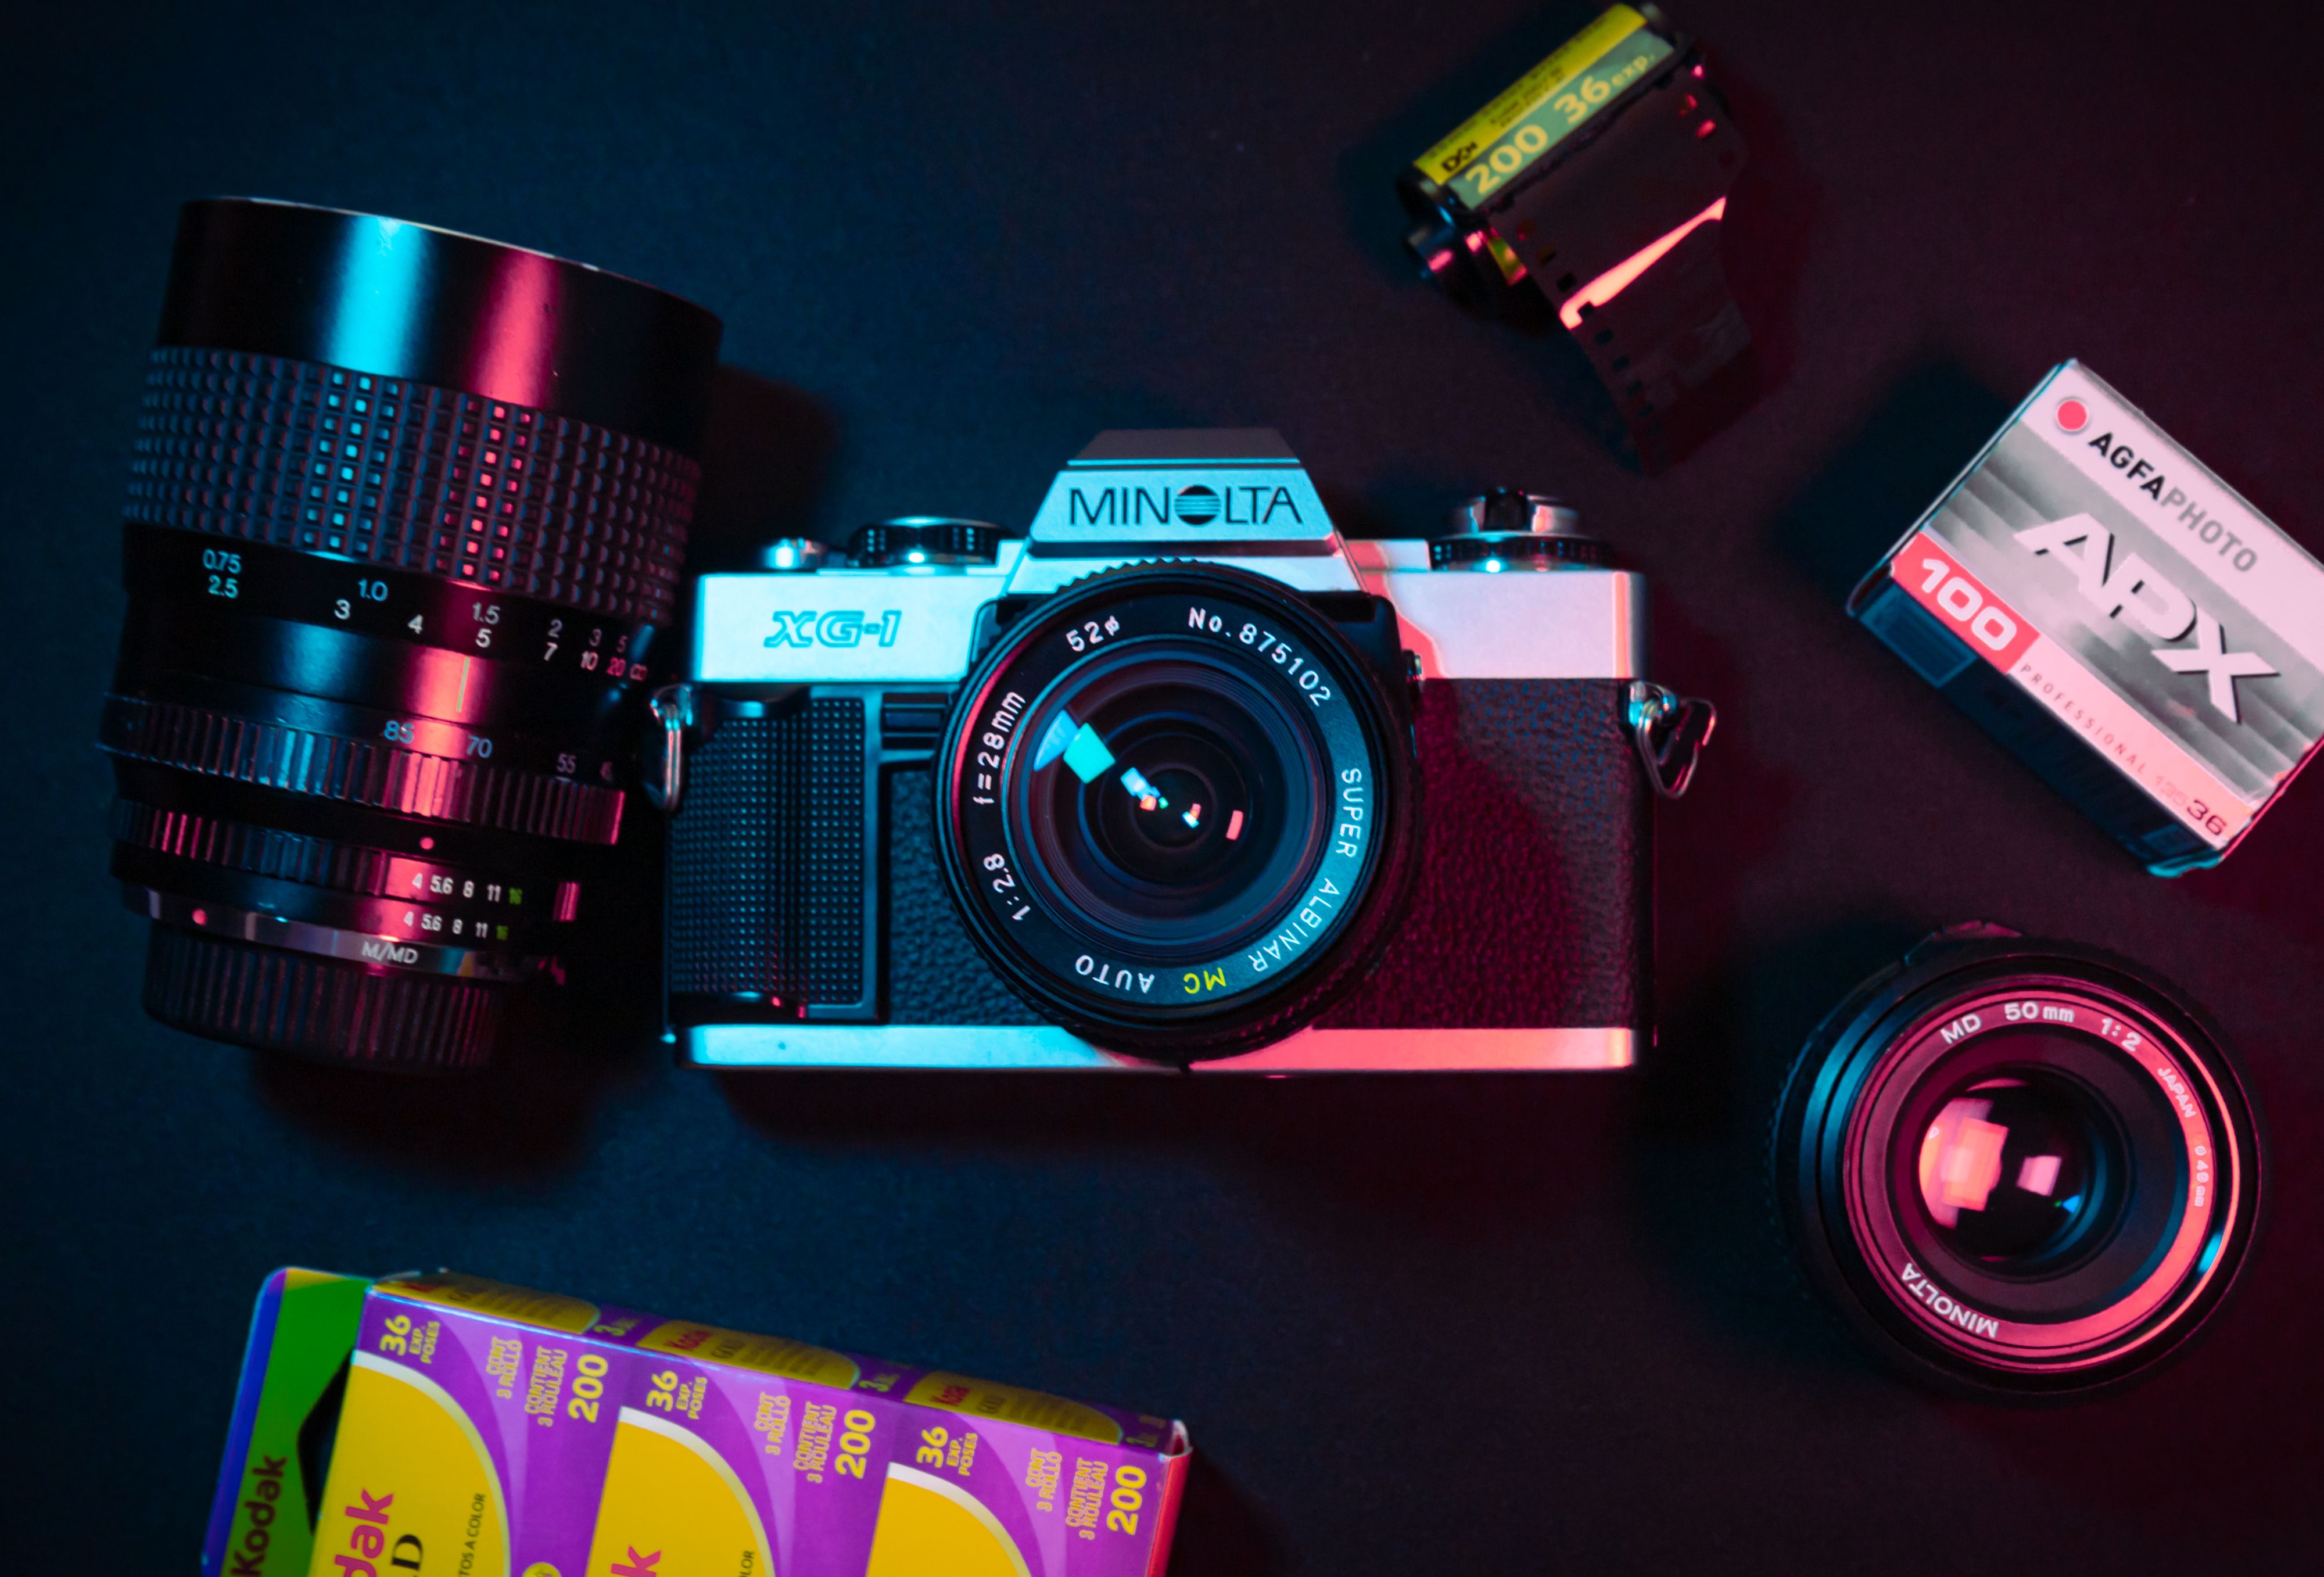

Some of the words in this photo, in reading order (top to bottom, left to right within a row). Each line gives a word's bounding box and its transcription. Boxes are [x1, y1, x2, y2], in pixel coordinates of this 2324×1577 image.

[1465, 124, 1548, 193] 200
[1554, 75, 1611, 124] 36
[1068, 483, 1304, 526] MINOLTA
[2088, 432, 2258, 573] AGFAPHOTO
[203, 549, 242, 574] 0.75
[358, 578, 388, 601] 1.0
[472, 601, 501, 625] 1.5
[548, 618, 562, 638] 2
[588, 628, 602, 647] 3
[207, 574, 239, 598] 2.5
[333, 599, 351, 620] 3
[408, 614, 423, 634] 4
[475, 628, 492, 648] 5
[543, 641, 558, 661] 7
[581, 650, 598, 671] 10
[606, 656, 626, 677] 20
[1921, 558, 2017, 651] 100
[2013, 512, 2281, 724] APX
[763, 610, 902, 647] XG-1
[383, 720, 414, 744] 85
[467, 736, 493, 758] 70
[557, 752, 576, 774] 55
[2021, 664, 2147, 775] PROFESSIONAL
[1335, 768, 1362, 859] SUPER
[2188, 798, 2228, 837] 36
[412, 873, 423, 890] 4
[463, 880, 474, 898] 8
[487, 884, 501, 902] 11
[983, 853, 1031, 922] 1:2.8
[361, 941, 418, 964] M/MD
[403, 911, 414, 927] 4
[452, 919, 463, 935] 8
[475, 922, 489, 939] 11
[1251, 878, 1341, 973] ALBINAR
[1075, 954, 1155, 994] AUTO
[1183, 967, 1227, 994] MC
[1940, 1014, 1982, 1044] MD
[2100, 1017, 2142, 1052] 1:2
[2157, 1067, 2197, 1119] JAPAN
[1900, 1262, 1999, 1339] MINOLTA
[379, 1315, 411, 1356] 36
[420, 1321, 440, 1364] POSES
[499, 1339, 522, 1388] ROLLO
[524, 1346, 551, 1414] CONTIENT
[540, 1349, 568, 1415] ROULEAU
[568, 1354, 608, 1423] 200
[645, 1370, 678, 1412] 36
[687, 1377, 707, 1420] POSES
[768, 1395, 791, 1443] ROLLO
[794, 1401, 821, 1471] CONTIENT
[808, 1405, 837, 1472] ROULEAU
[835, 1409, 876, 1479] 200
[916, 1427, 948, 1468] 36
[959, 1432, 977, 1476] POSES
[1039, 1451, 1063, 1500] ROLLO
[231, 1456, 287, 1577] Kodak
[467, 1493, 486, 1538] COLOR
[1066, 1457, 1093, 1527] CONTIENT
[1081, 1461, 1109, 1528] ROULEAU
[1106, 1465, 1147, 1536] 200
[464, 1540, 475, 1550] A
